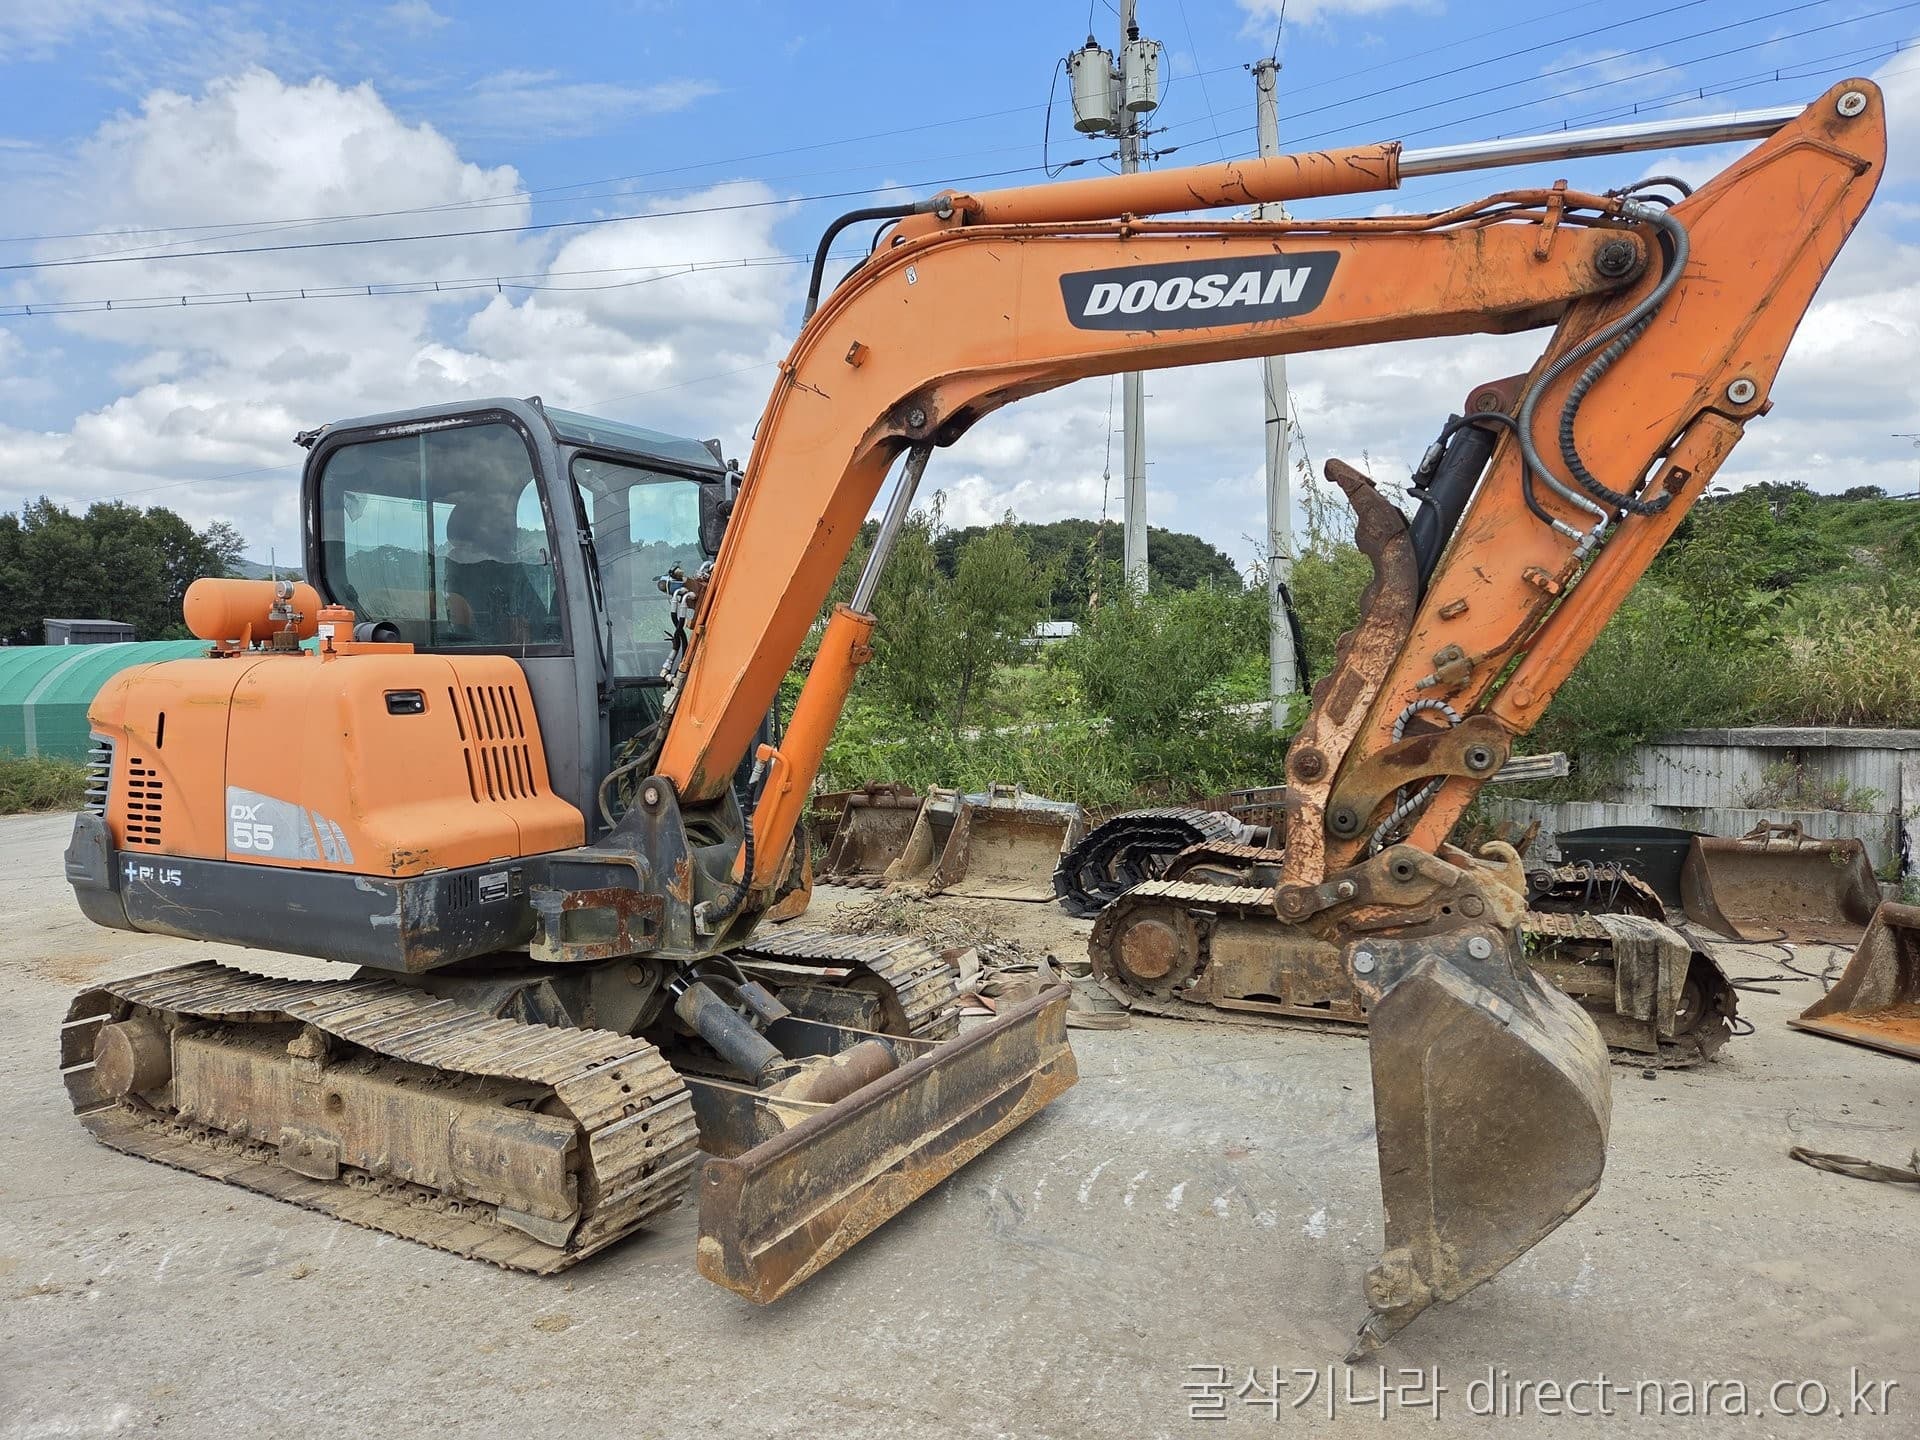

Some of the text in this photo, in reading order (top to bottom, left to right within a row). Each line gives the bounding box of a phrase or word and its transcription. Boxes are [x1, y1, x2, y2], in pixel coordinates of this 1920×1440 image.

[1083, 267, 1312, 316] DOOSAN
[230, 802, 265, 821] DX
[233, 821, 274, 851] 55
